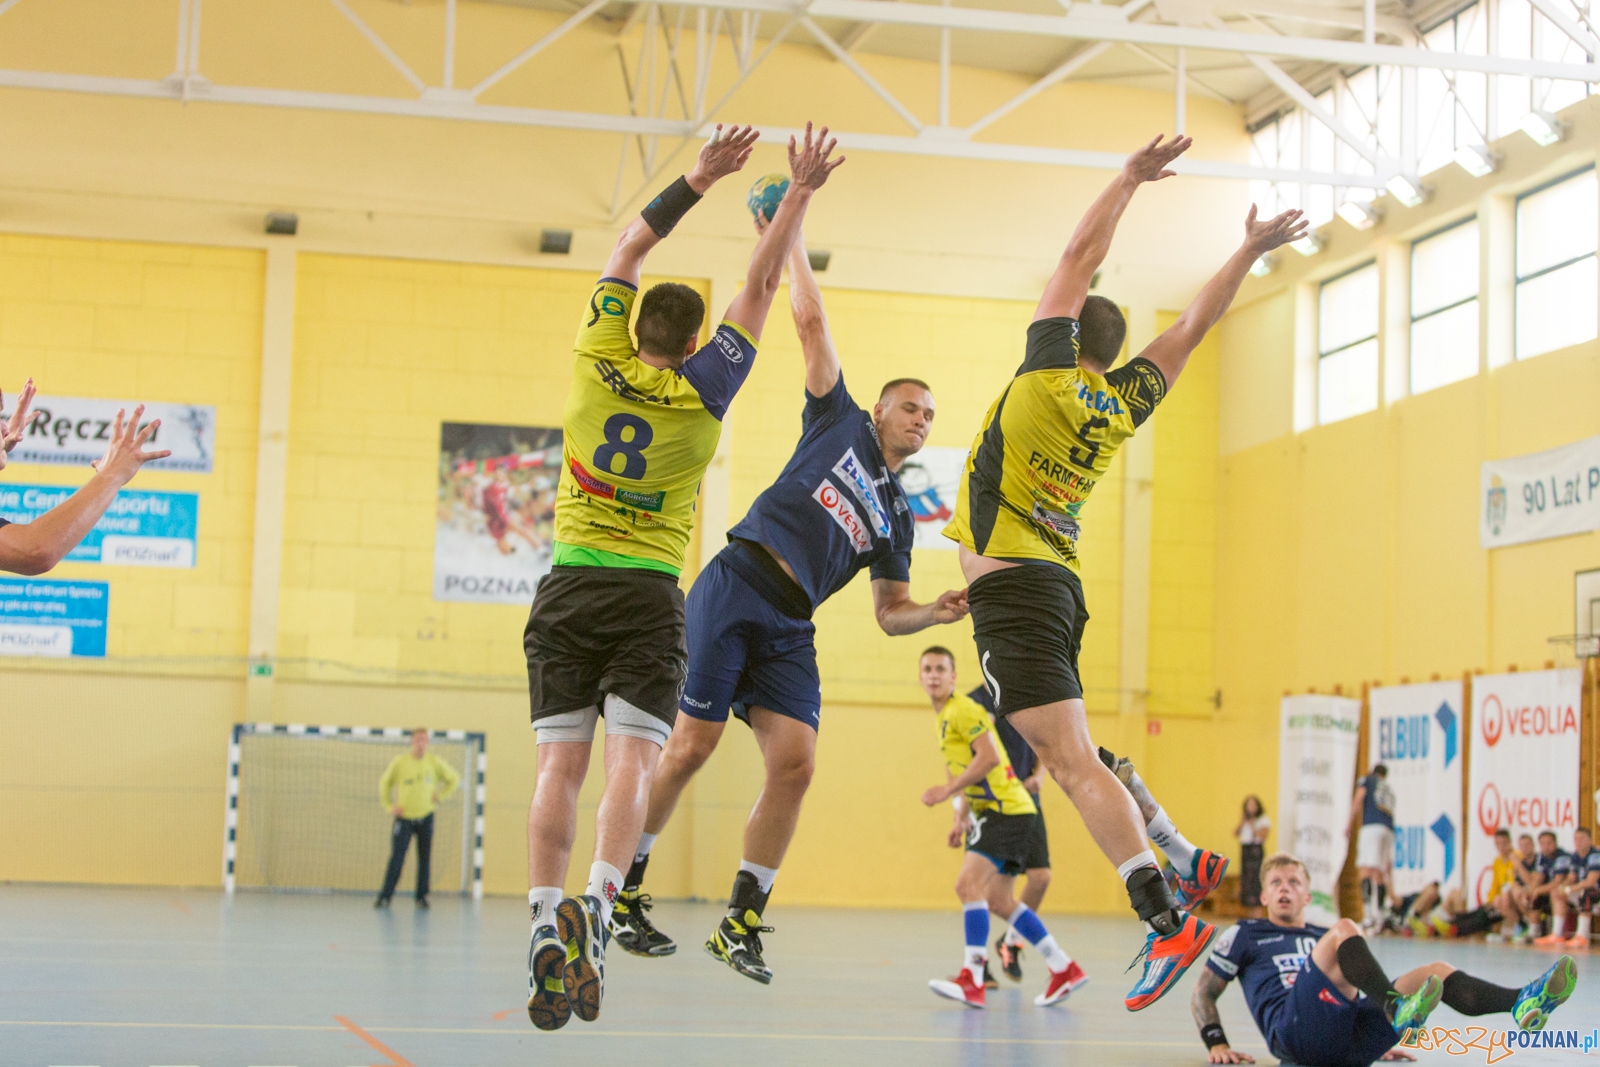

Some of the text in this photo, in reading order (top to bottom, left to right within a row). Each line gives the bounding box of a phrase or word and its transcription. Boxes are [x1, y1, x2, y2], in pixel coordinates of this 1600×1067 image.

[29, 408, 158, 447] Ręcza
[593, 412, 653, 481] 8
[1069, 414, 1110, 470] 5
[622, 490, 659, 504] AGROMIX
[1523, 479, 1546, 515] 90
[1551, 472, 1581, 508] Lat
[589, 520, 629, 535] Sporting
[838, 504, 867, 549] VEOLIA
[1378, 714, 1430, 761] ELBUD
[1506, 704, 1577, 736] VEOLIA
[1503, 797, 1574, 828] VEOLIA
